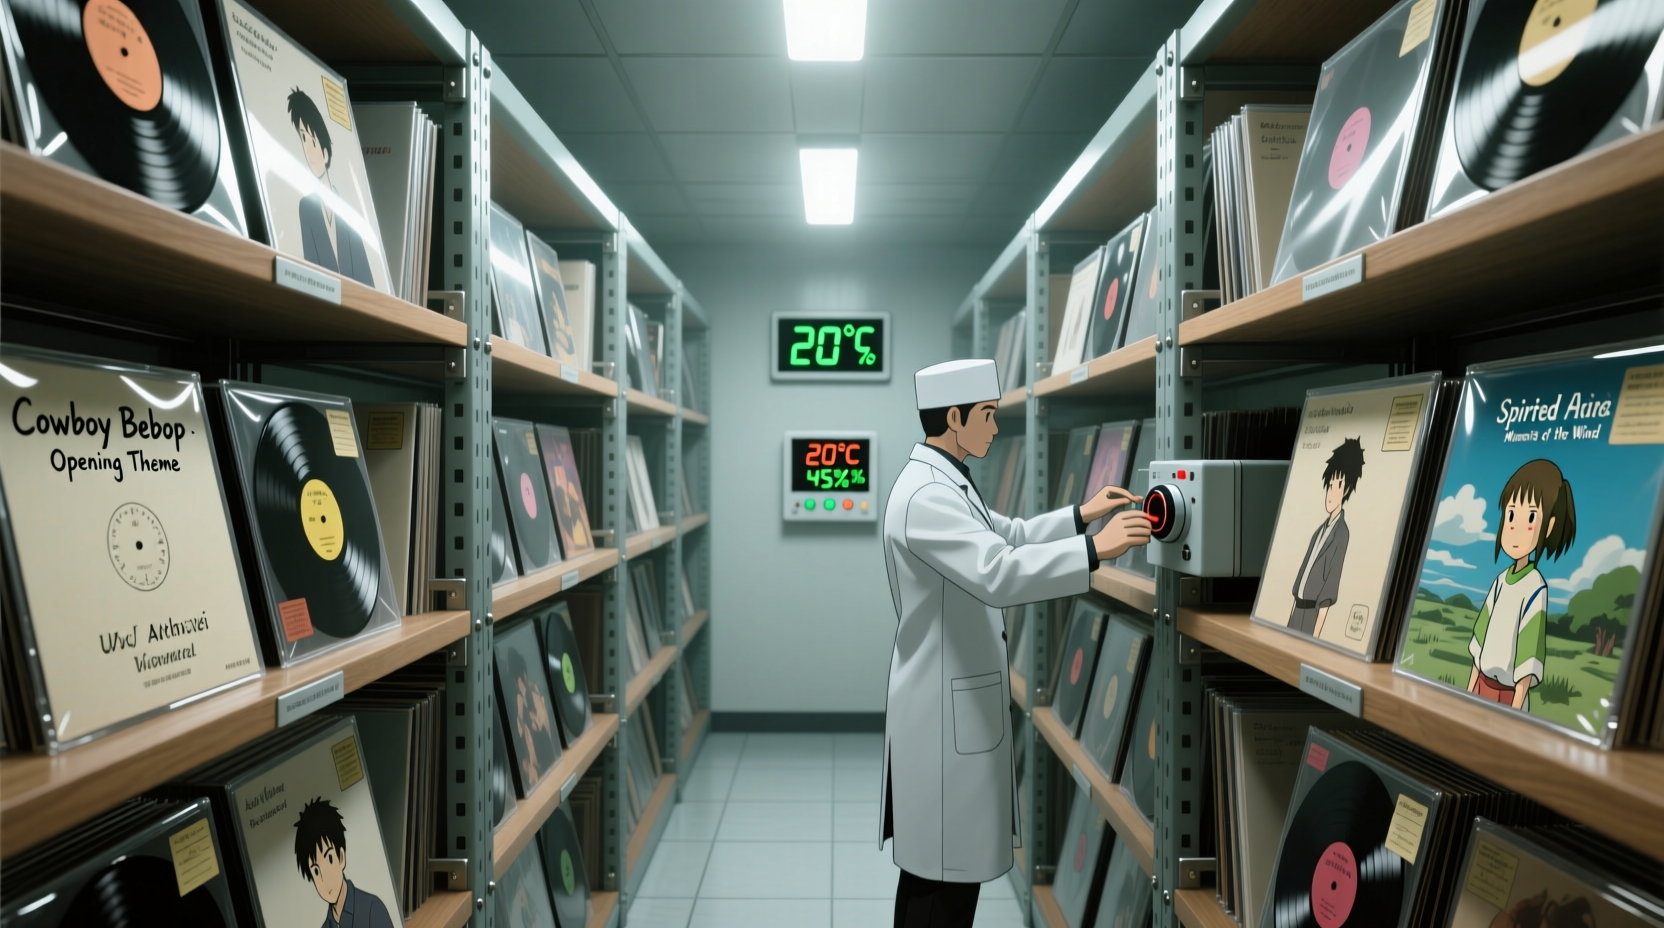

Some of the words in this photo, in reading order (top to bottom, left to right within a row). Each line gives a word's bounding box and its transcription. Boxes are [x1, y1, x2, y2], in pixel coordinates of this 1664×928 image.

[12, 396, 111, 449] Cowboy
[50, 448, 123, 482] Opening
[127, 450, 180, 471] Theme
[805, 443, 860, 466] 20°C
